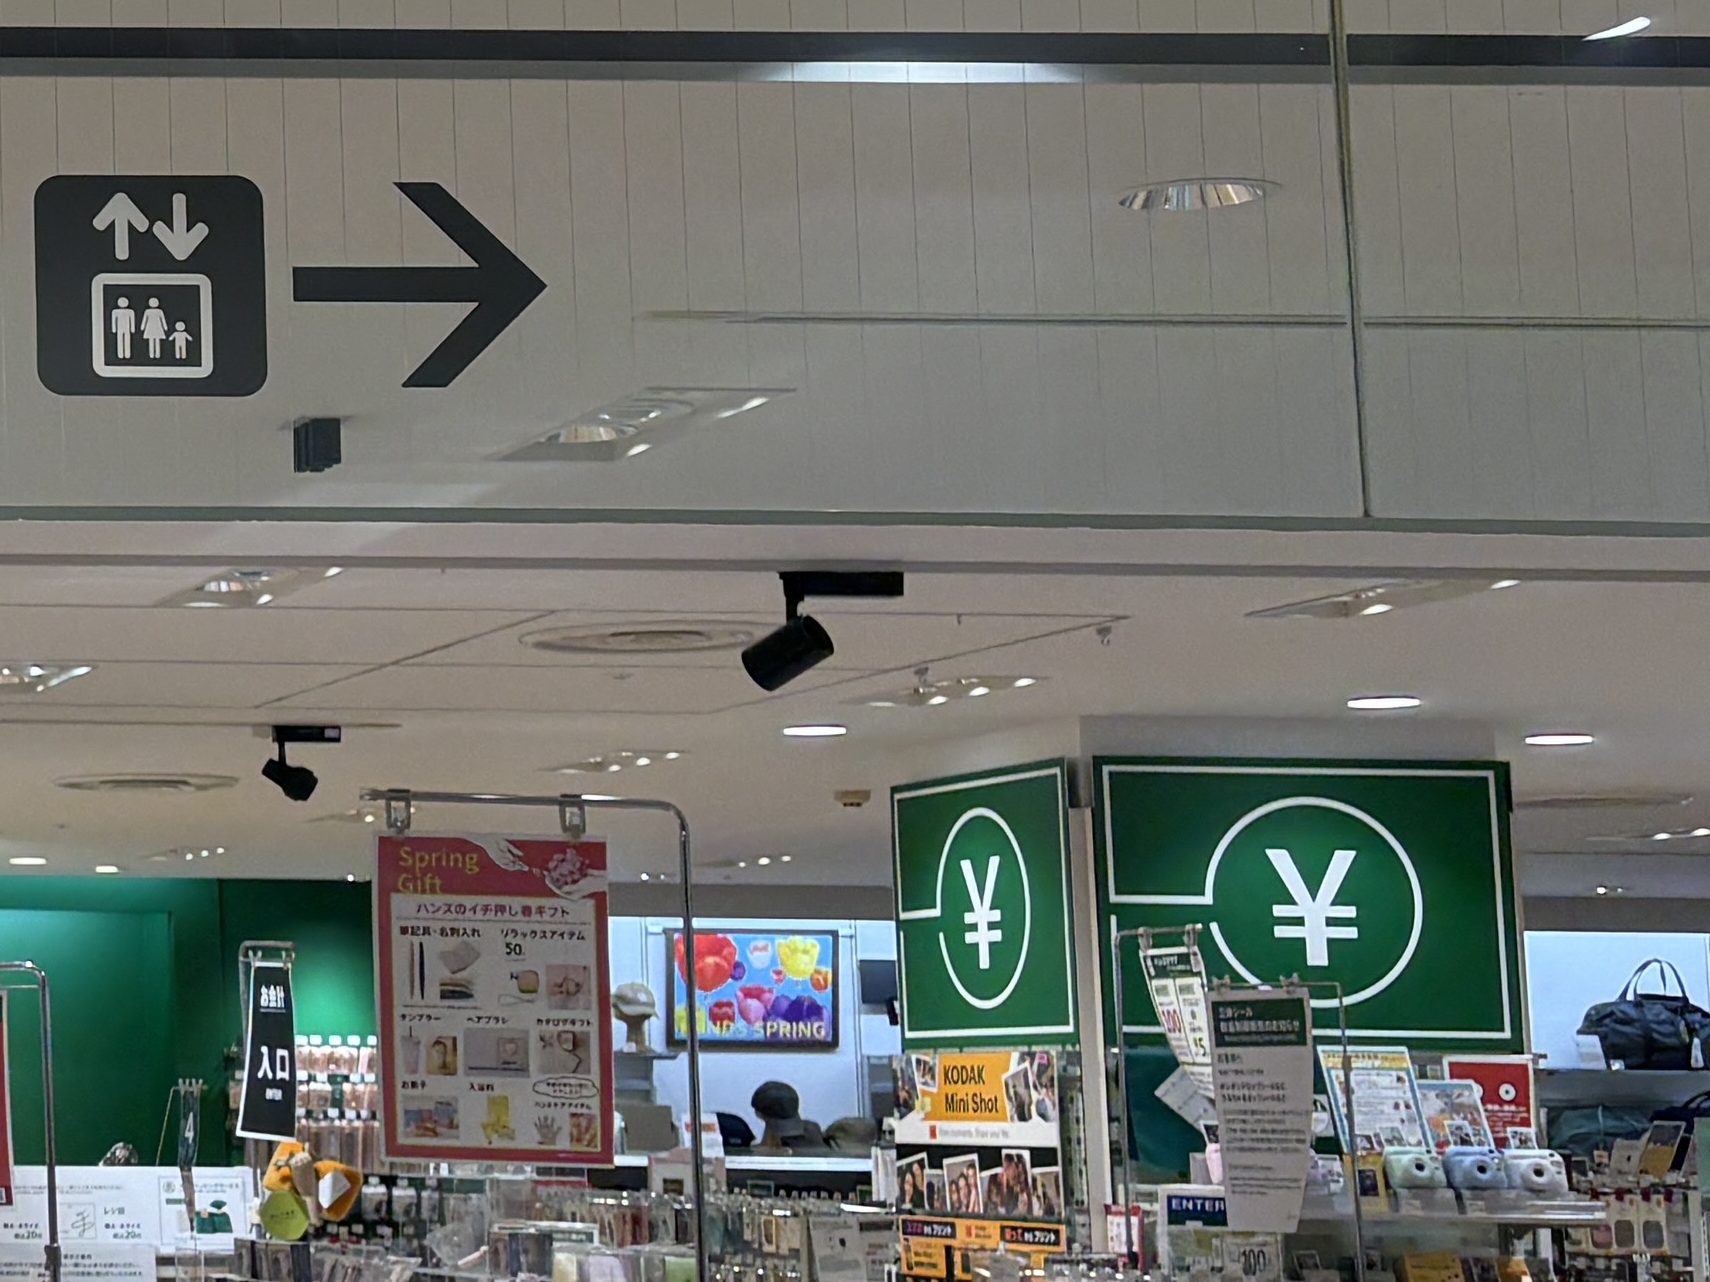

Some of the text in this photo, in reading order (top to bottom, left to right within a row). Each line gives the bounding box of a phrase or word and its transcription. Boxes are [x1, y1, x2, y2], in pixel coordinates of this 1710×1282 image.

[398, 846, 480, 875] Spring
[397, 874, 443, 894] Gift
[257, 1046, 290, 1082] 入口
[943, 1064, 986, 1086] KODAK
[944, 1092, 999, 1113] Mini Shot
